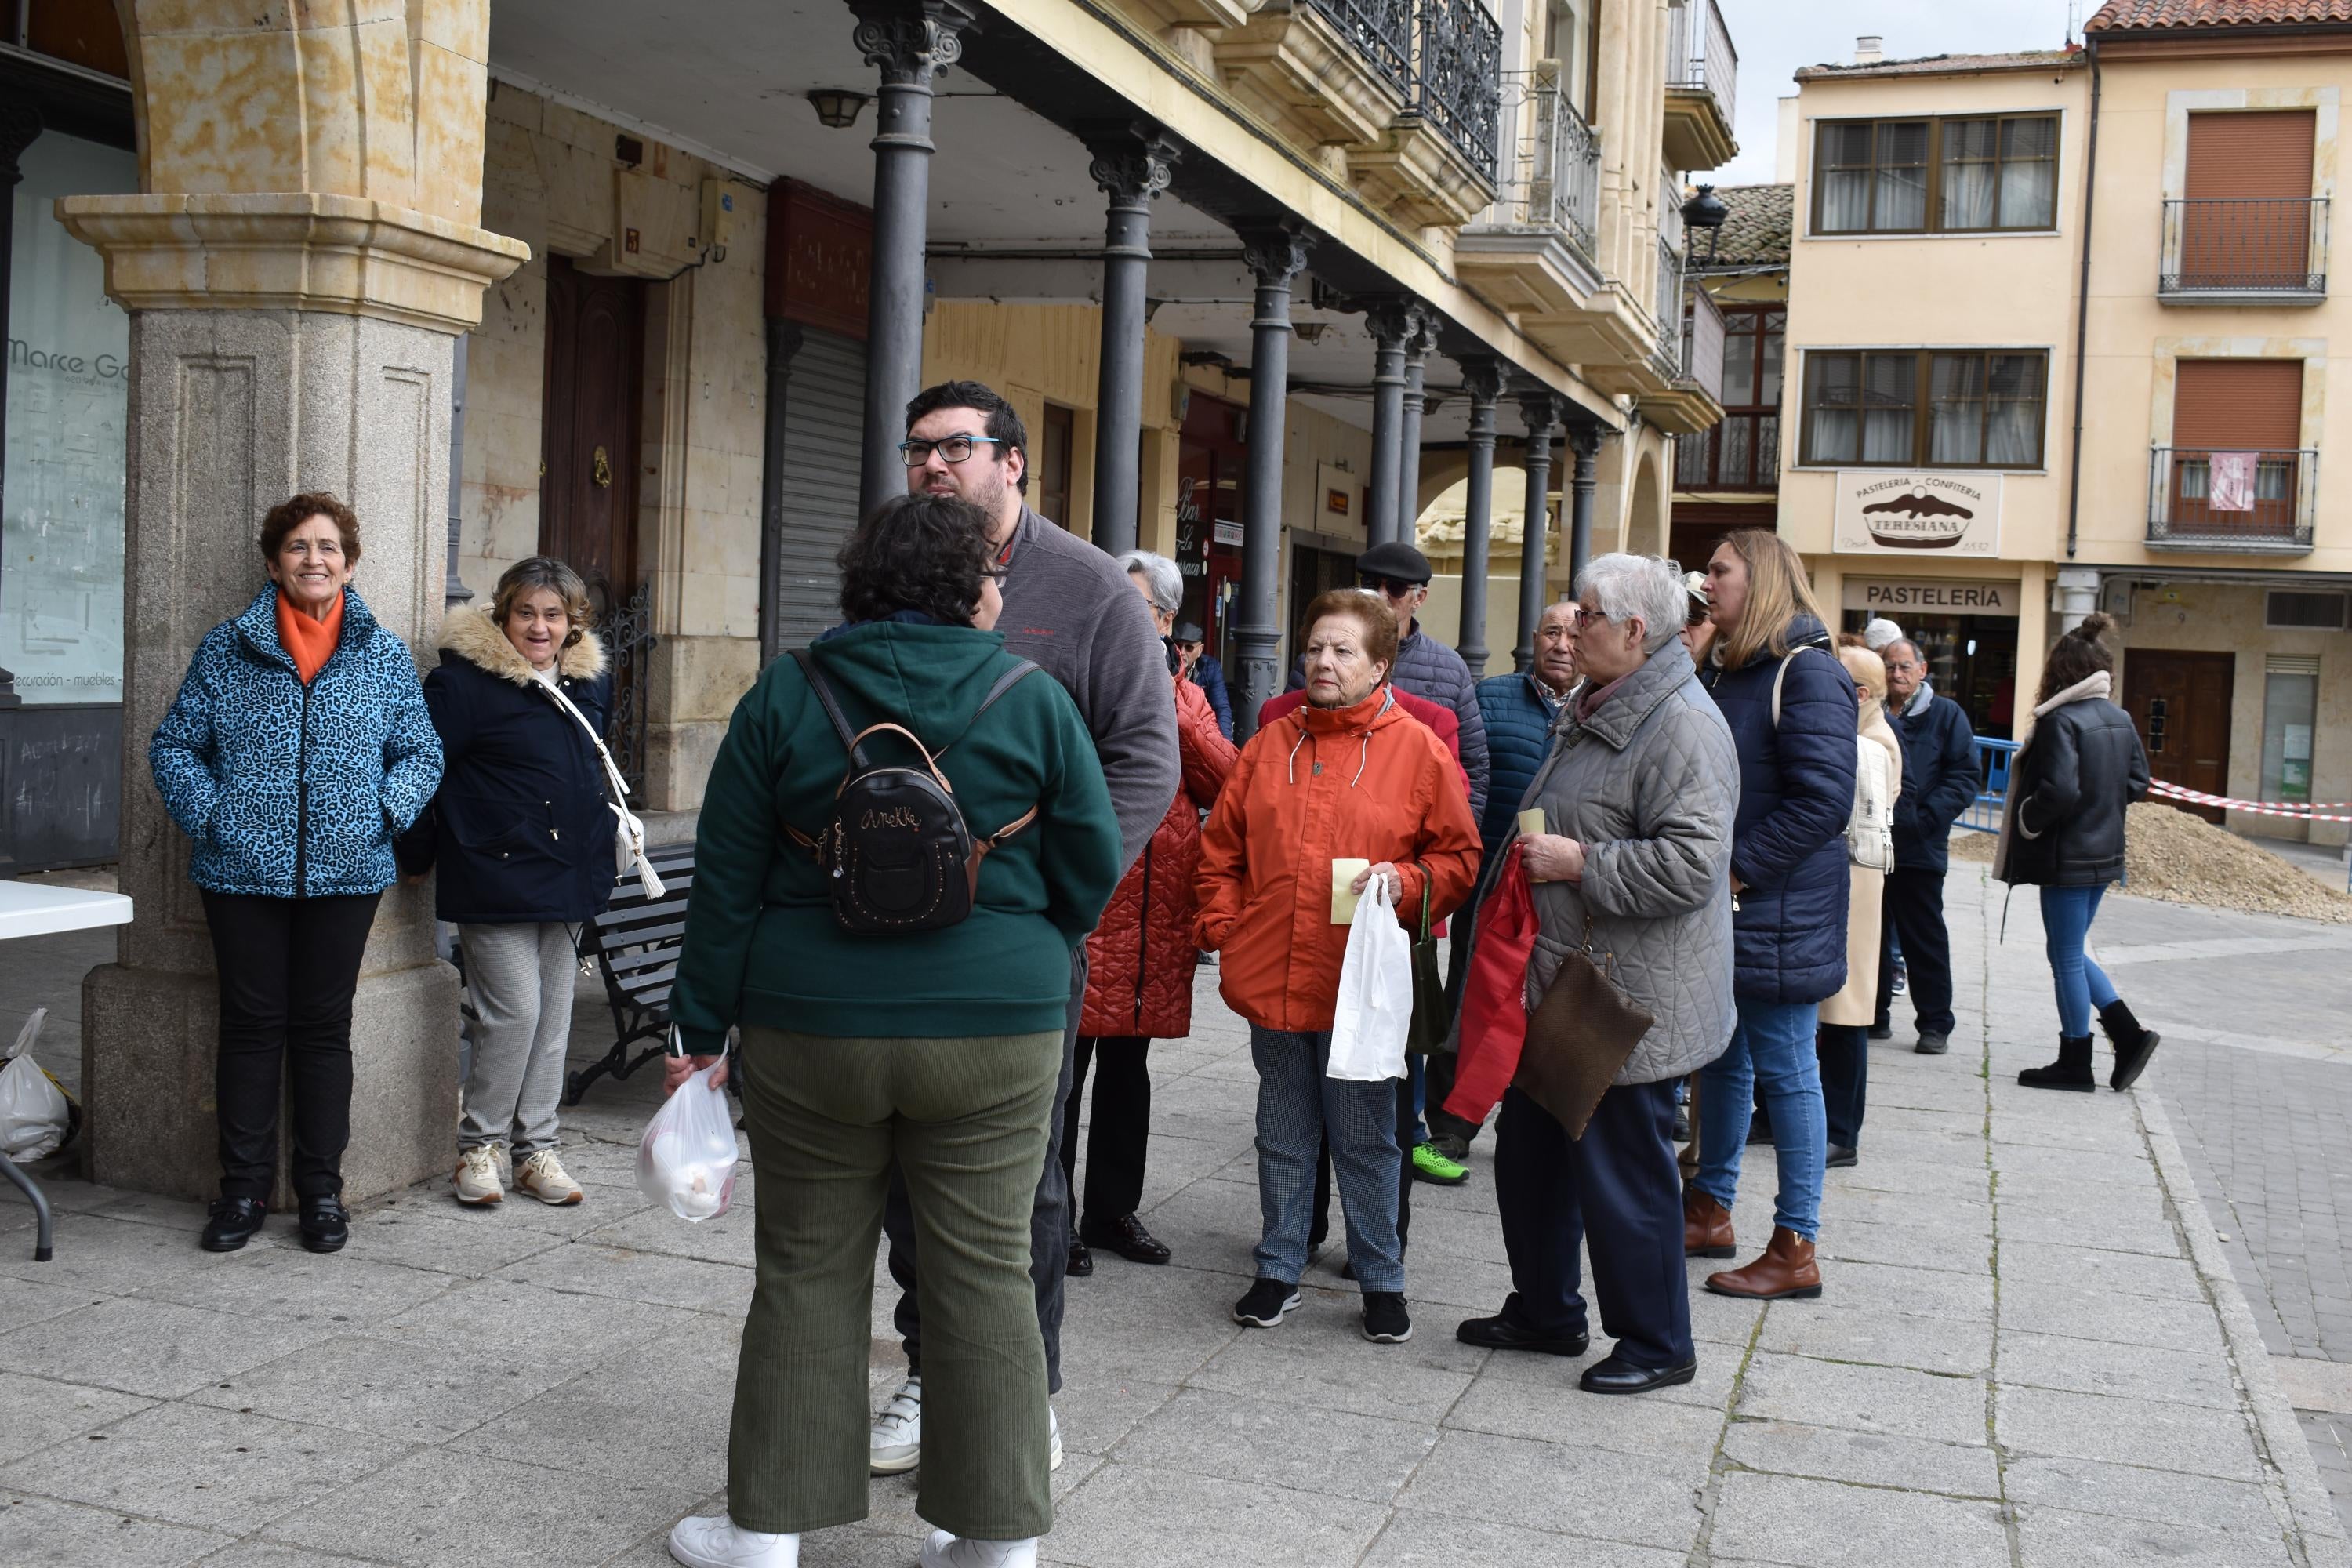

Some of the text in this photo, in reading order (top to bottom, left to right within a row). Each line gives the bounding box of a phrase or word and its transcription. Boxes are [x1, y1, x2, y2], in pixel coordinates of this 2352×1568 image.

[1177, 477, 1200, 521] Bar
[1856, 477, 1911, 499] PASTELERIA
[1925, 477, 1981, 501] CONFITERIA
[1874, 520, 1958, 532] TERESIANA
[1867, 585, 2002, 608] PASTELERÍA
[74, 672, 114, 687] muebles
